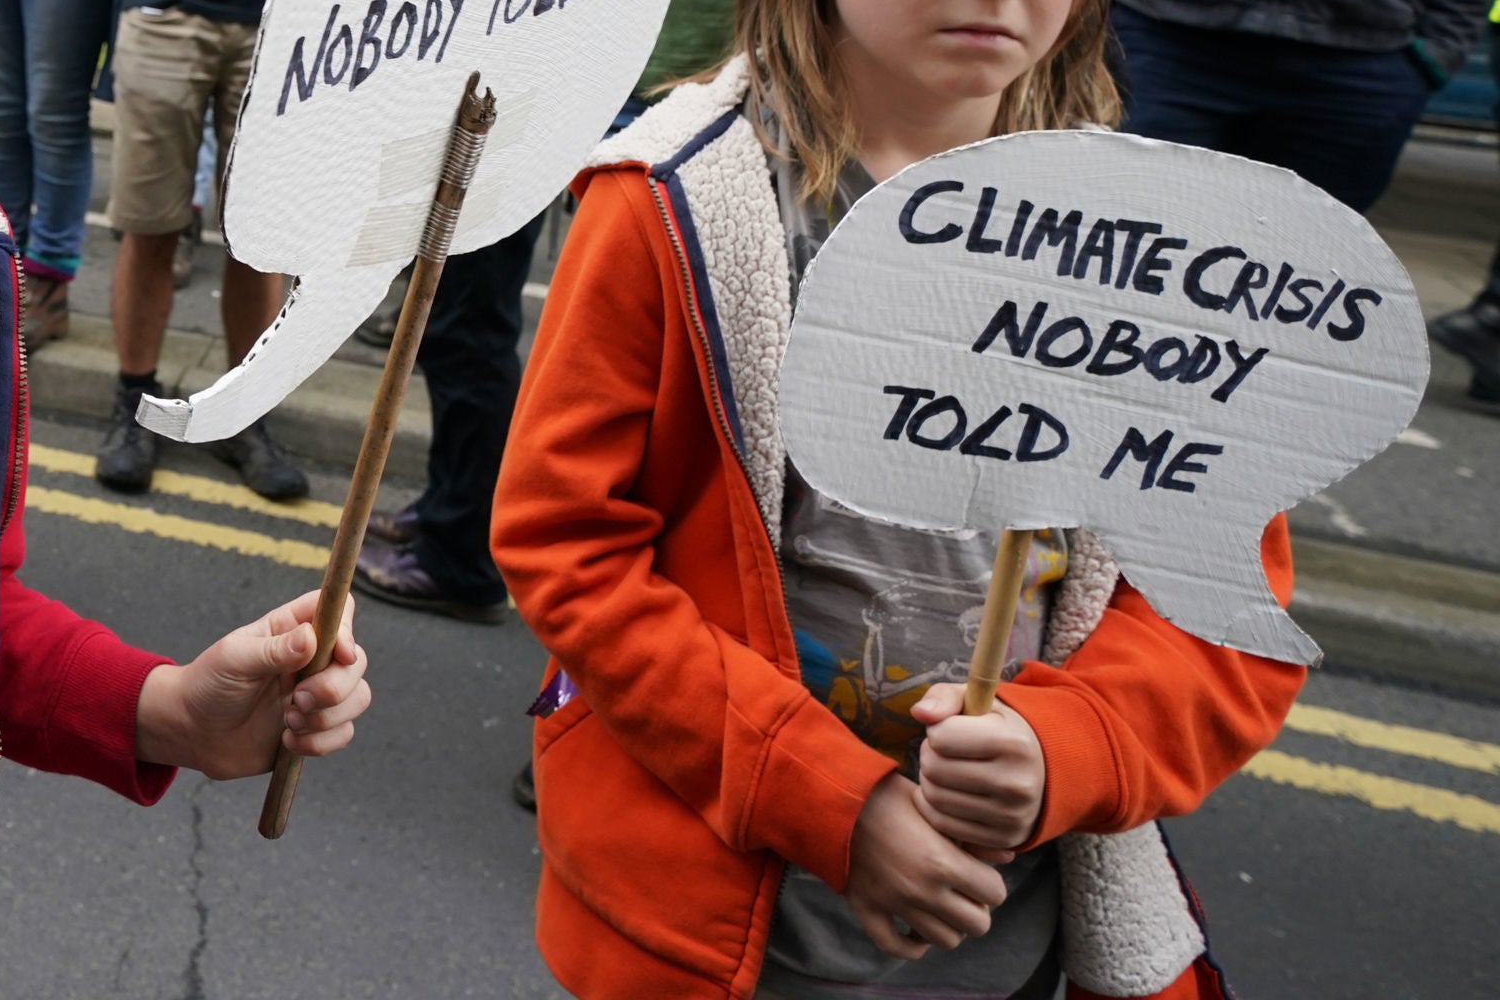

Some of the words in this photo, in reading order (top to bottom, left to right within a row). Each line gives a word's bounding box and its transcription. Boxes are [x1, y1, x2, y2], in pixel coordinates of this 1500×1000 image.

[898, 180, 1187, 295] CLIMATE
[1182, 245, 1382, 342] CRISIS
[971, 300, 1269, 403] NOBODY
[882, 385, 1070, 463] TOLD
[1099, 427, 1224, 493] ME
